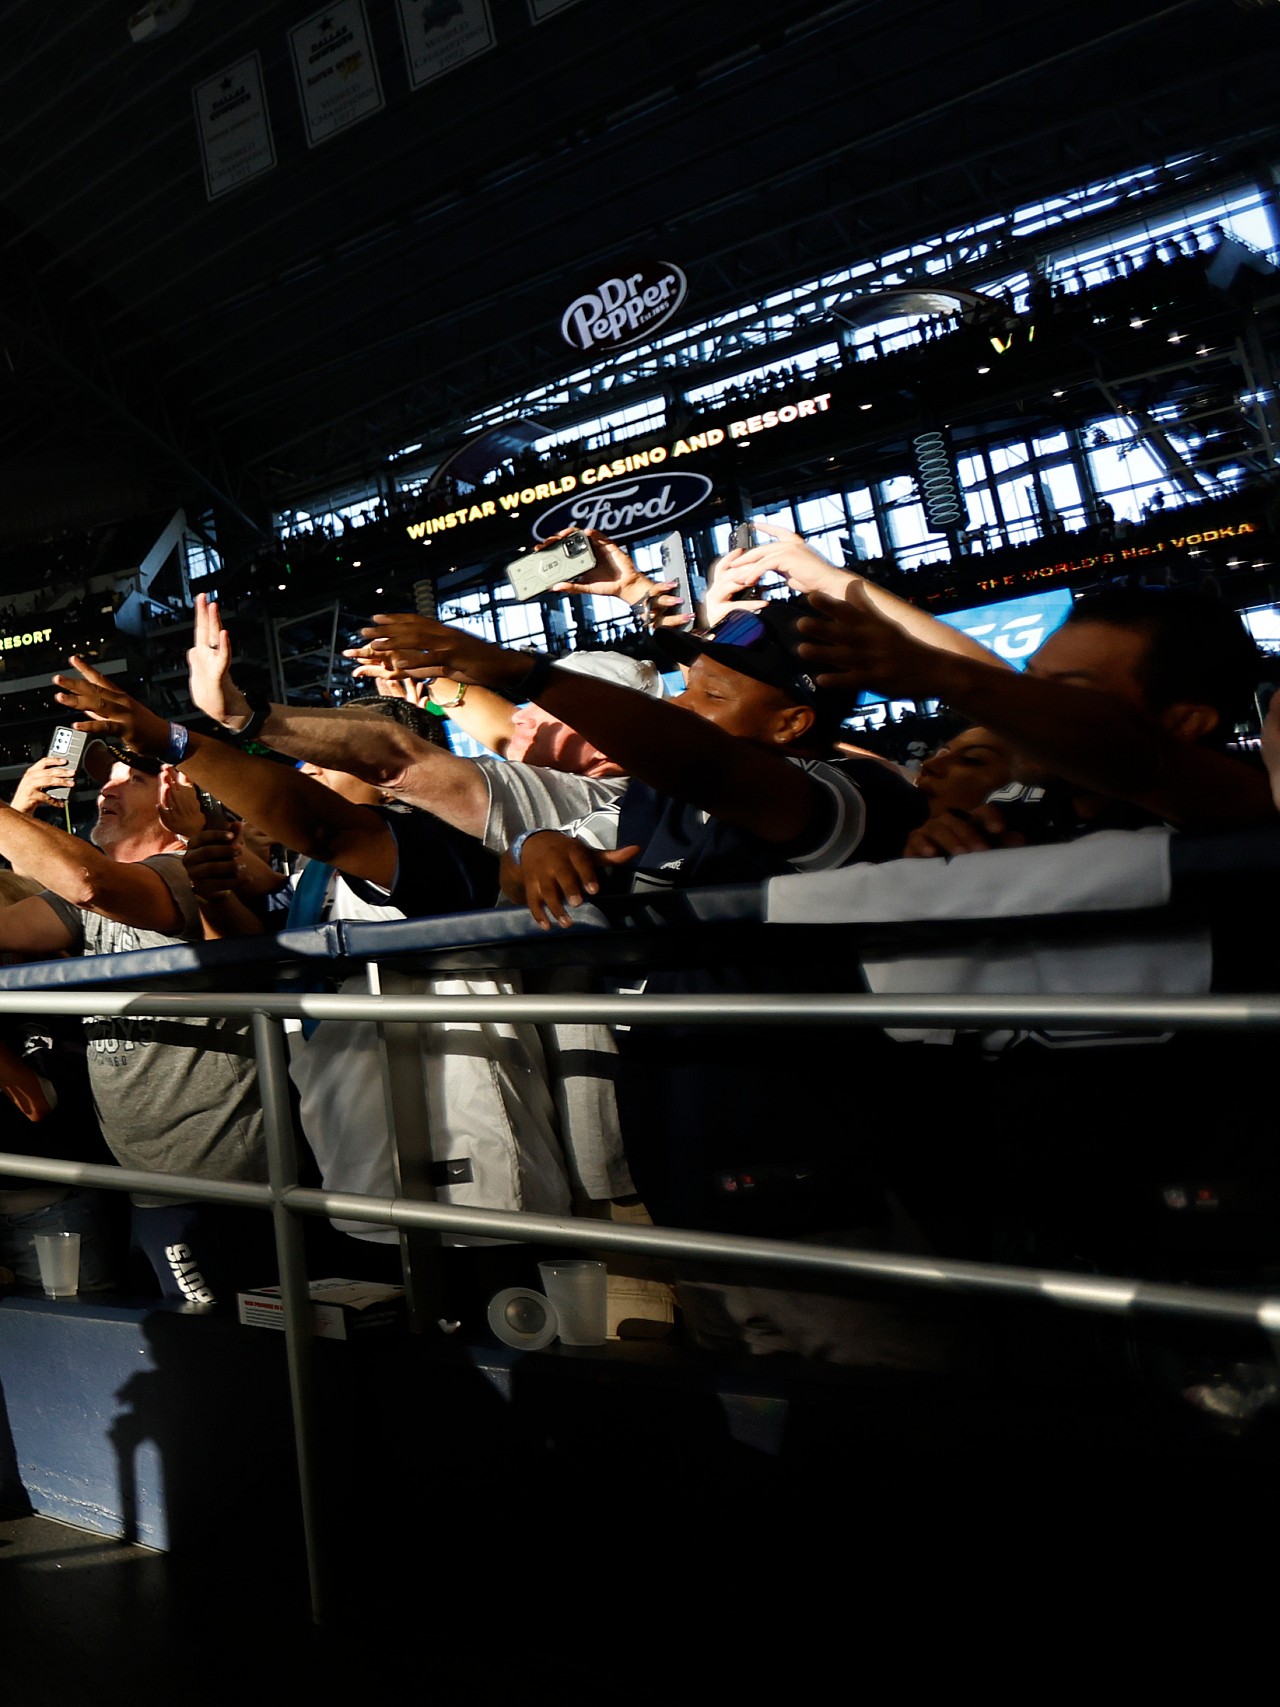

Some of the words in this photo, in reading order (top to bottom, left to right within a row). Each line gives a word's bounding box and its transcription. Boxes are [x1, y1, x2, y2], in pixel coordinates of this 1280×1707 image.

[561, 275, 676, 350] Pepper
[598, 273, 644, 315] Dr
[406, 500, 497, 540] WINSTAR
[498, 475, 577, 511] WORLD
[580, 446, 668, 485] CASINO
[671, 428, 725, 457] AND
[726, 393, 832, 440] RESORT
[567, 484, 677, 531] Ford
[1169, 522, 1258, 549] VODKA
